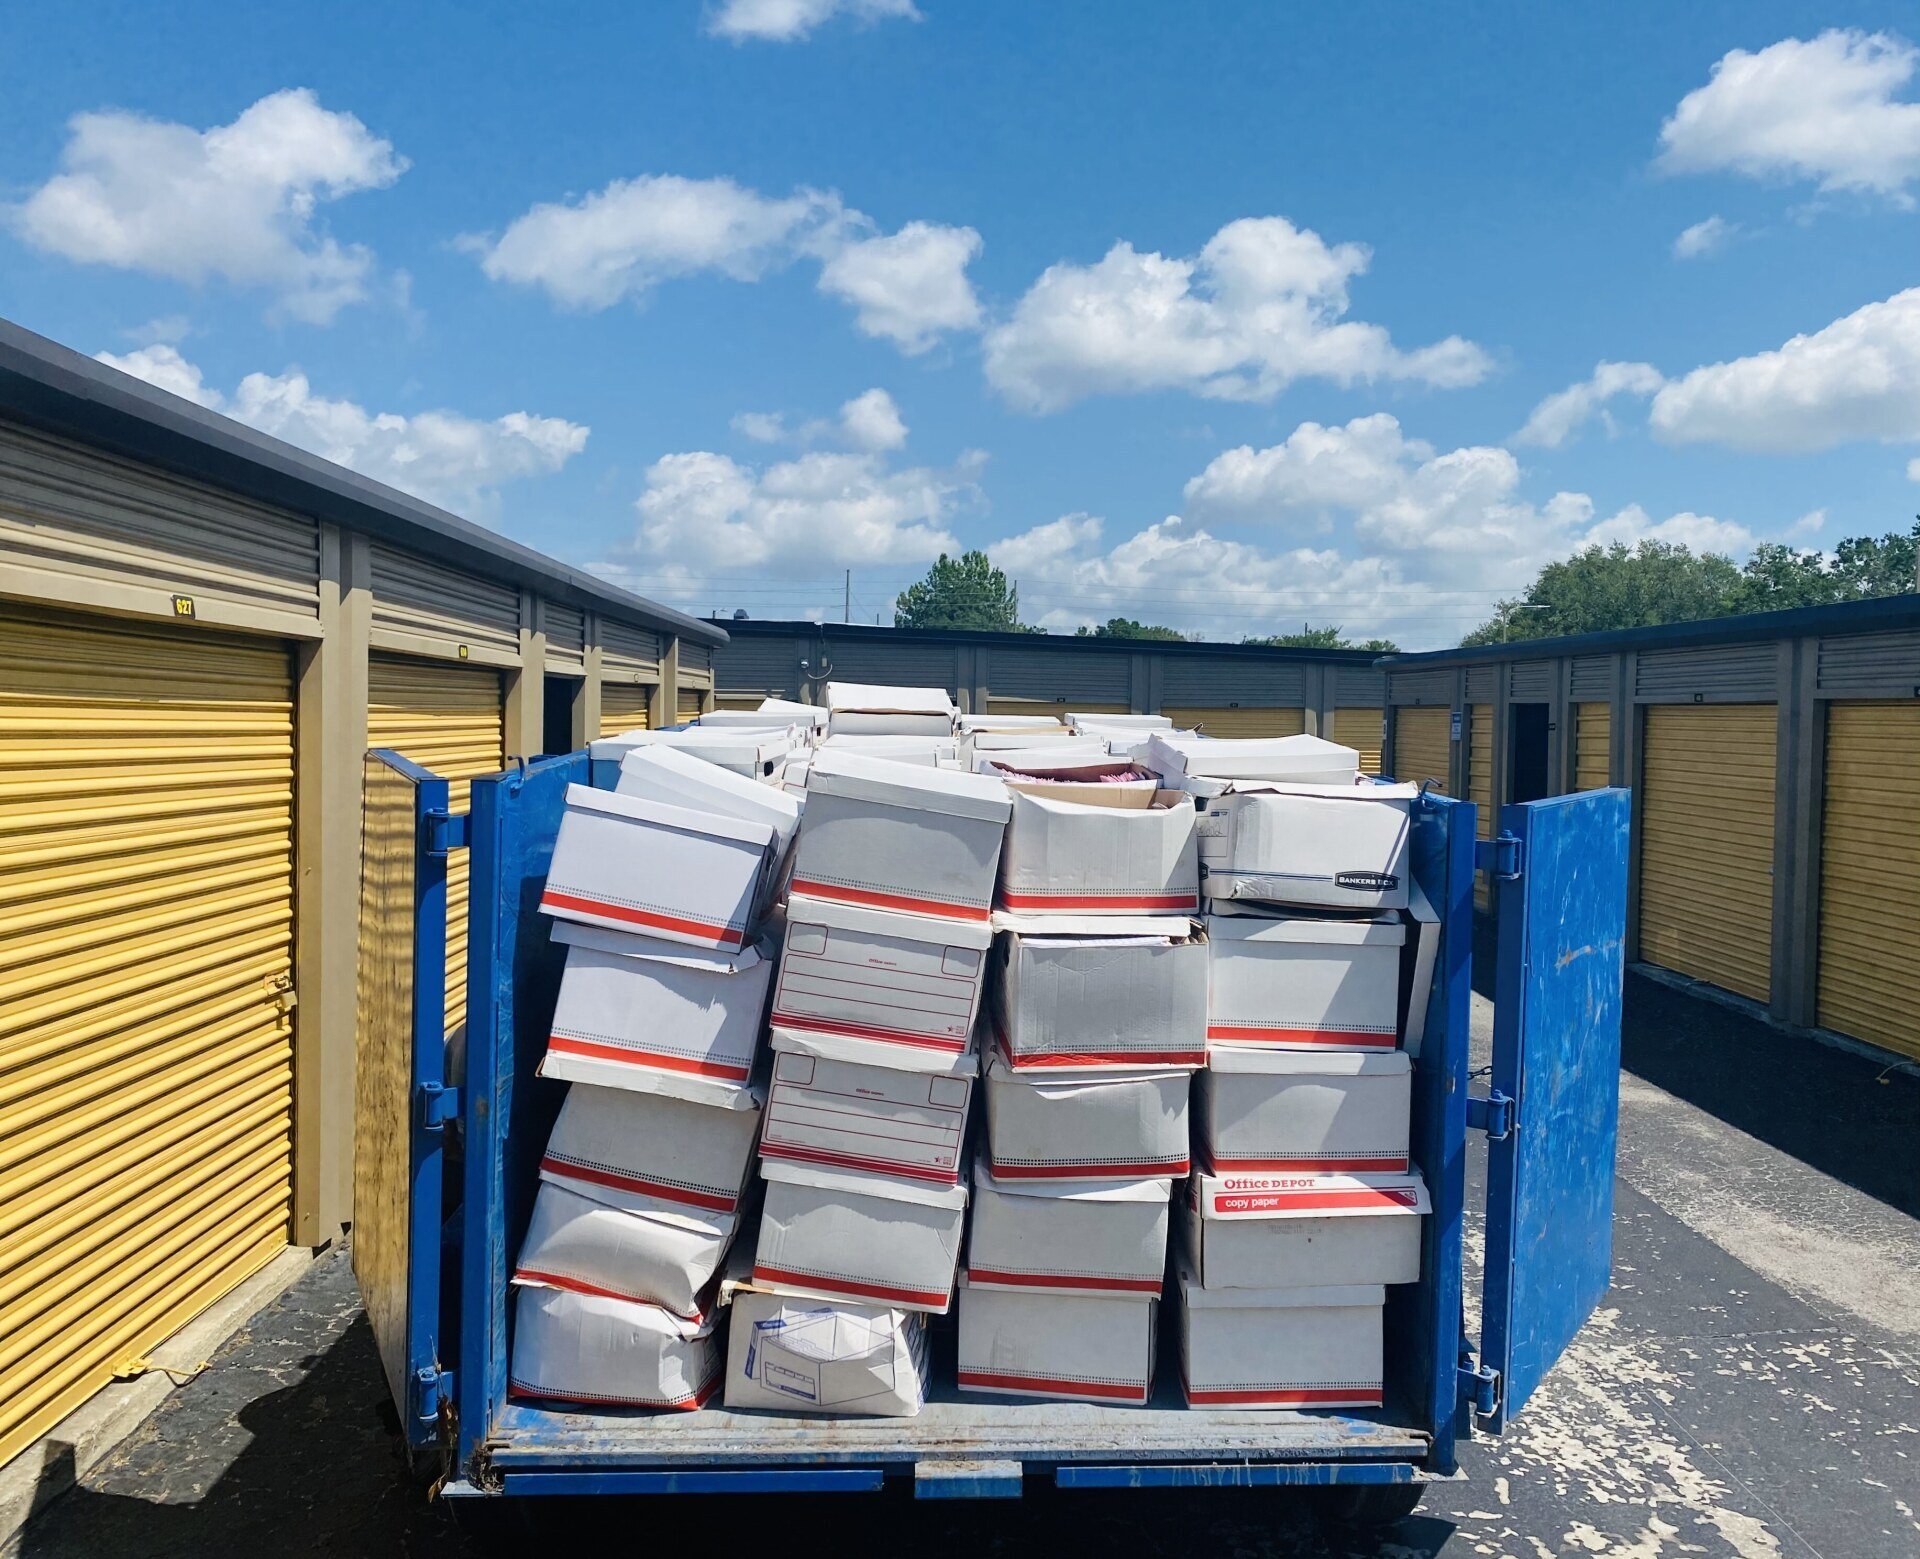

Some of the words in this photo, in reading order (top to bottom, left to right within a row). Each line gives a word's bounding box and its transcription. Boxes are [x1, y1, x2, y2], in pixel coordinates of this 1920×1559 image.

[176, 599, 192, 615] 627
[1339, 876, 1376, 885] BANKERS
[1224, 1178, 1269, 1189] Office
[1271, 1179, 1315, 1188] DEPOT
[1225, 1199, 1249, 1208] copy
[1251, 1198, 1279, 1208] paper
